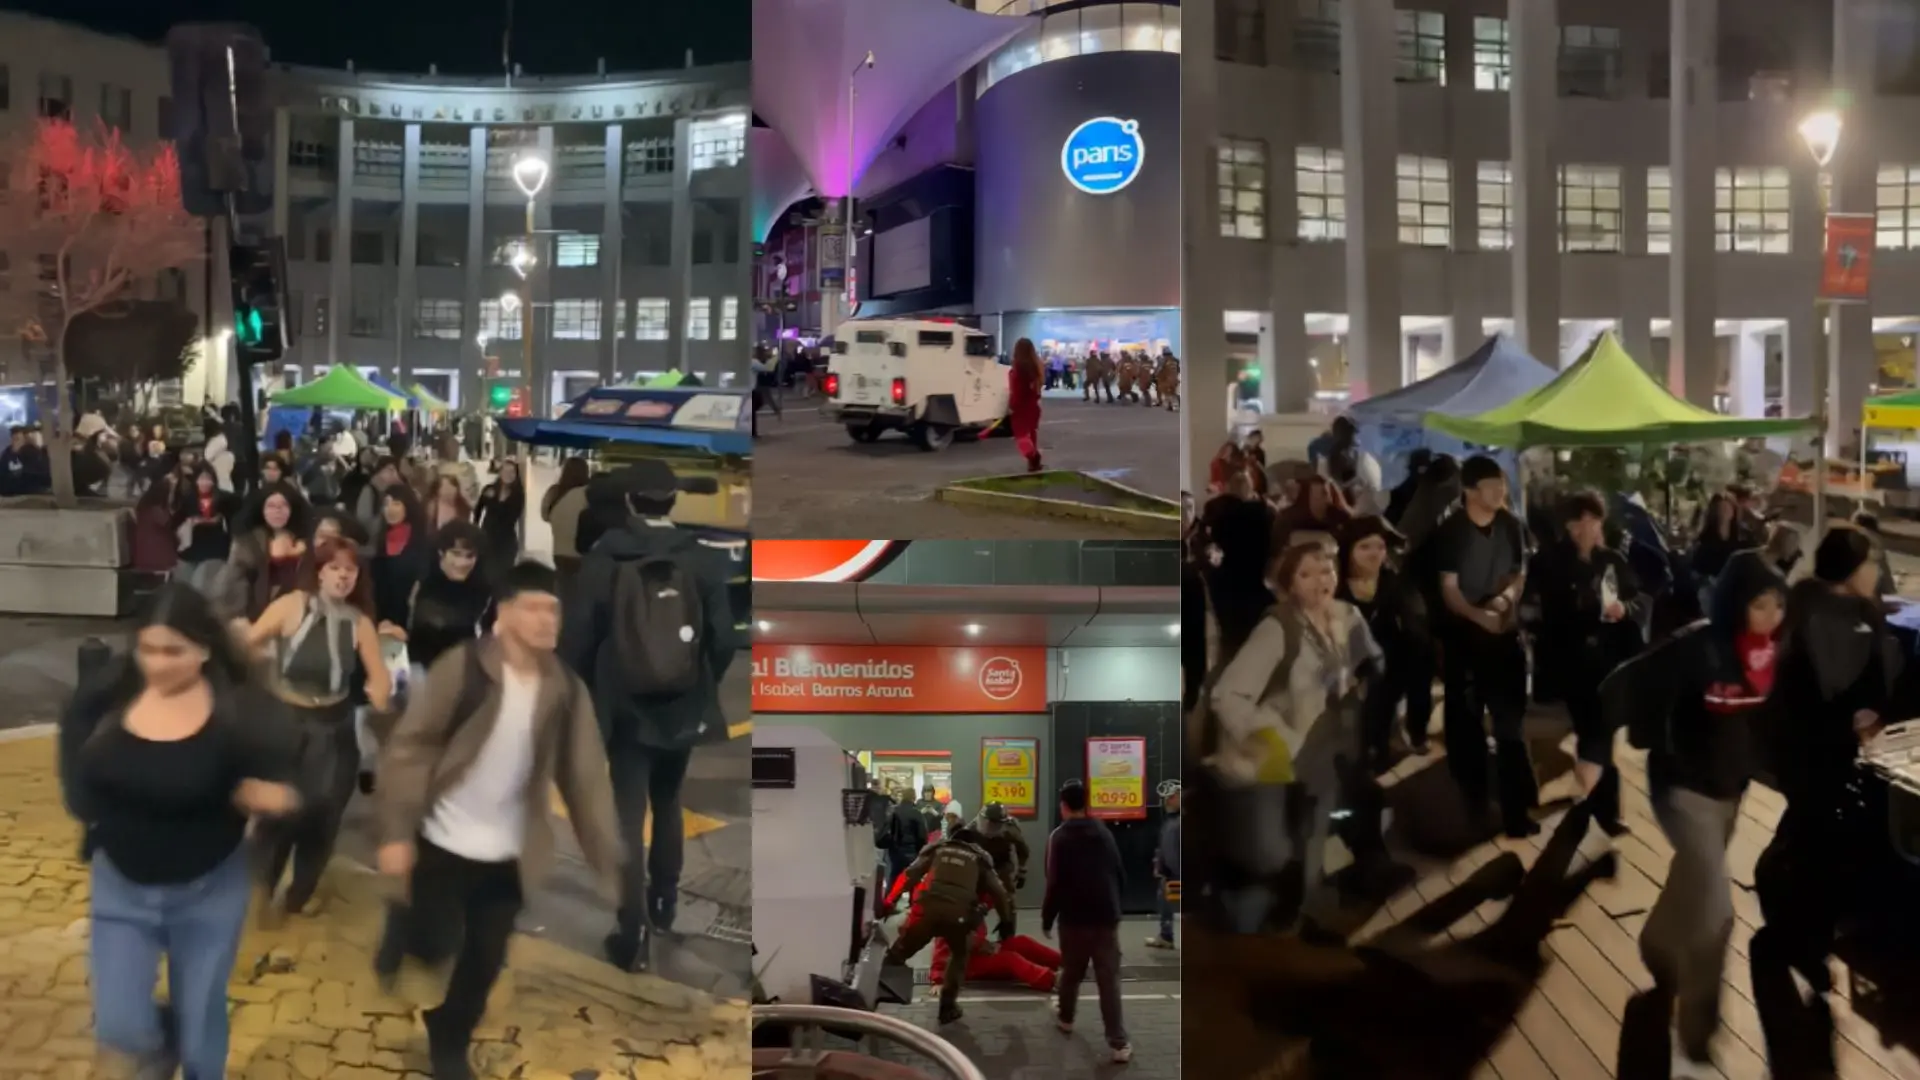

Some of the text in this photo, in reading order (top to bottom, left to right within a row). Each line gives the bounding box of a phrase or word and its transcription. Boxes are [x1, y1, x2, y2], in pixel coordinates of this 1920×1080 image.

[1073, 144, 1133, 171] paris
[774, 657, 915, 679] Bienvenidos
[760, 681, 806, 697] Isabel
[812, 682, 862, 697] Barros
[866, 684, 914, 698] Arana
